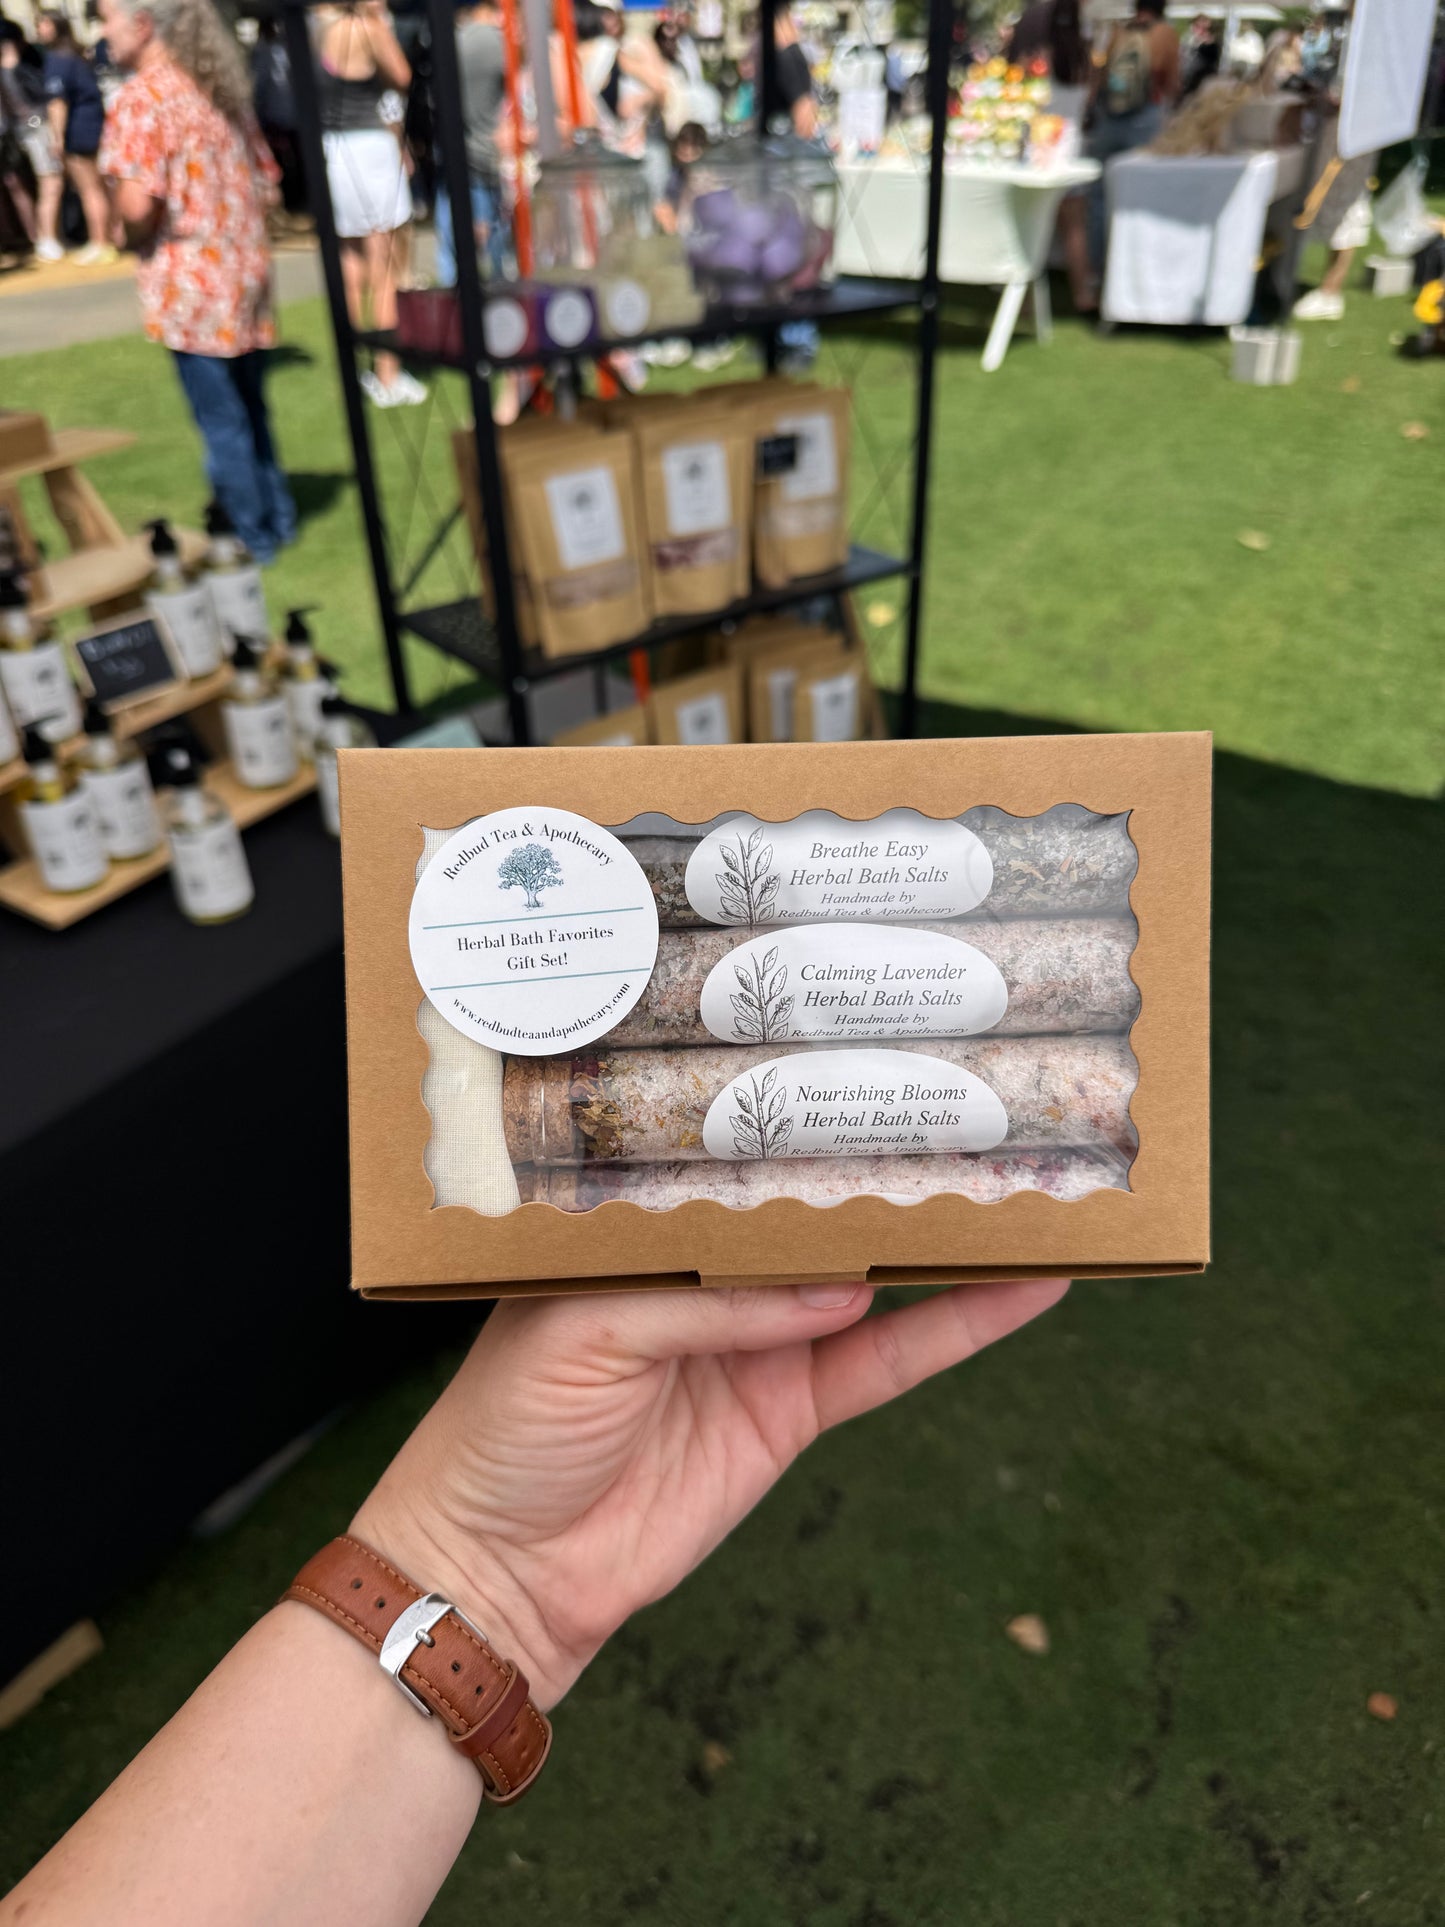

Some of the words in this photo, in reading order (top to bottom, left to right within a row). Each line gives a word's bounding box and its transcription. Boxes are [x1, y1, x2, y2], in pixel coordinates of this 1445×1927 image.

[443, 837, 490, 880] Redbud
[490, 829, 517, 845] Tea
[521, 823, 534, 836] &
[540, 823, 614, 867] Apothecary
[810, 842, 878, 859] Breathe
[885, 840, 928, 860] Easy
[789, 868, 853, 886] Herbal
[858, 867, 900, 884] Bath
[905, 866, 949, 883] Salts
[821, 892, 895, 904] Handmade
[899, 891, 916, 904] by
[778, 908, 830, 918] Redbud
[835, 908, 856, 917] Tea
[860, 908, 872, 916] &
[877, 906, 955, 917] Apothecary
[457, 934, 505, 951] Herbal
[510, 930, 543, 947] Bath
[549, 927, 614, 943] Favorites
[507, 955, 535, 970] Gift
[540, 953, 568, 967] Set!
[800, 964, 877, 984] Calming
[882, 963, 967, 980] Lavender
[804, 990, 867, 1007] Herbal
[871, 990, 914, 1006] Bath
[919, 989, 963, 1006] Salts
[453, 982, 630, 1040] www.redbudteaandapothecary.com
[834, 1014, 909, 1025] Handmade
[913, 1013, 929, 1025] by
[791, 1029, 844, 1037] Redbud
[847, 1028, 870, 1036] Tea
[889, 1027, 968, 1036] Apothecary
[796, 1084, 896, 1105] Nourishing
[902, 1084, 967, 1101] Blooms
[802, 1111, 866, 1128] Herbal
[871, 1111, 913, 1127] Bath
[917, 1110, 961, 1126] Salts
[833, 1134, 908, 1144] Handmade
[911, 1133, 928, 1144] by
